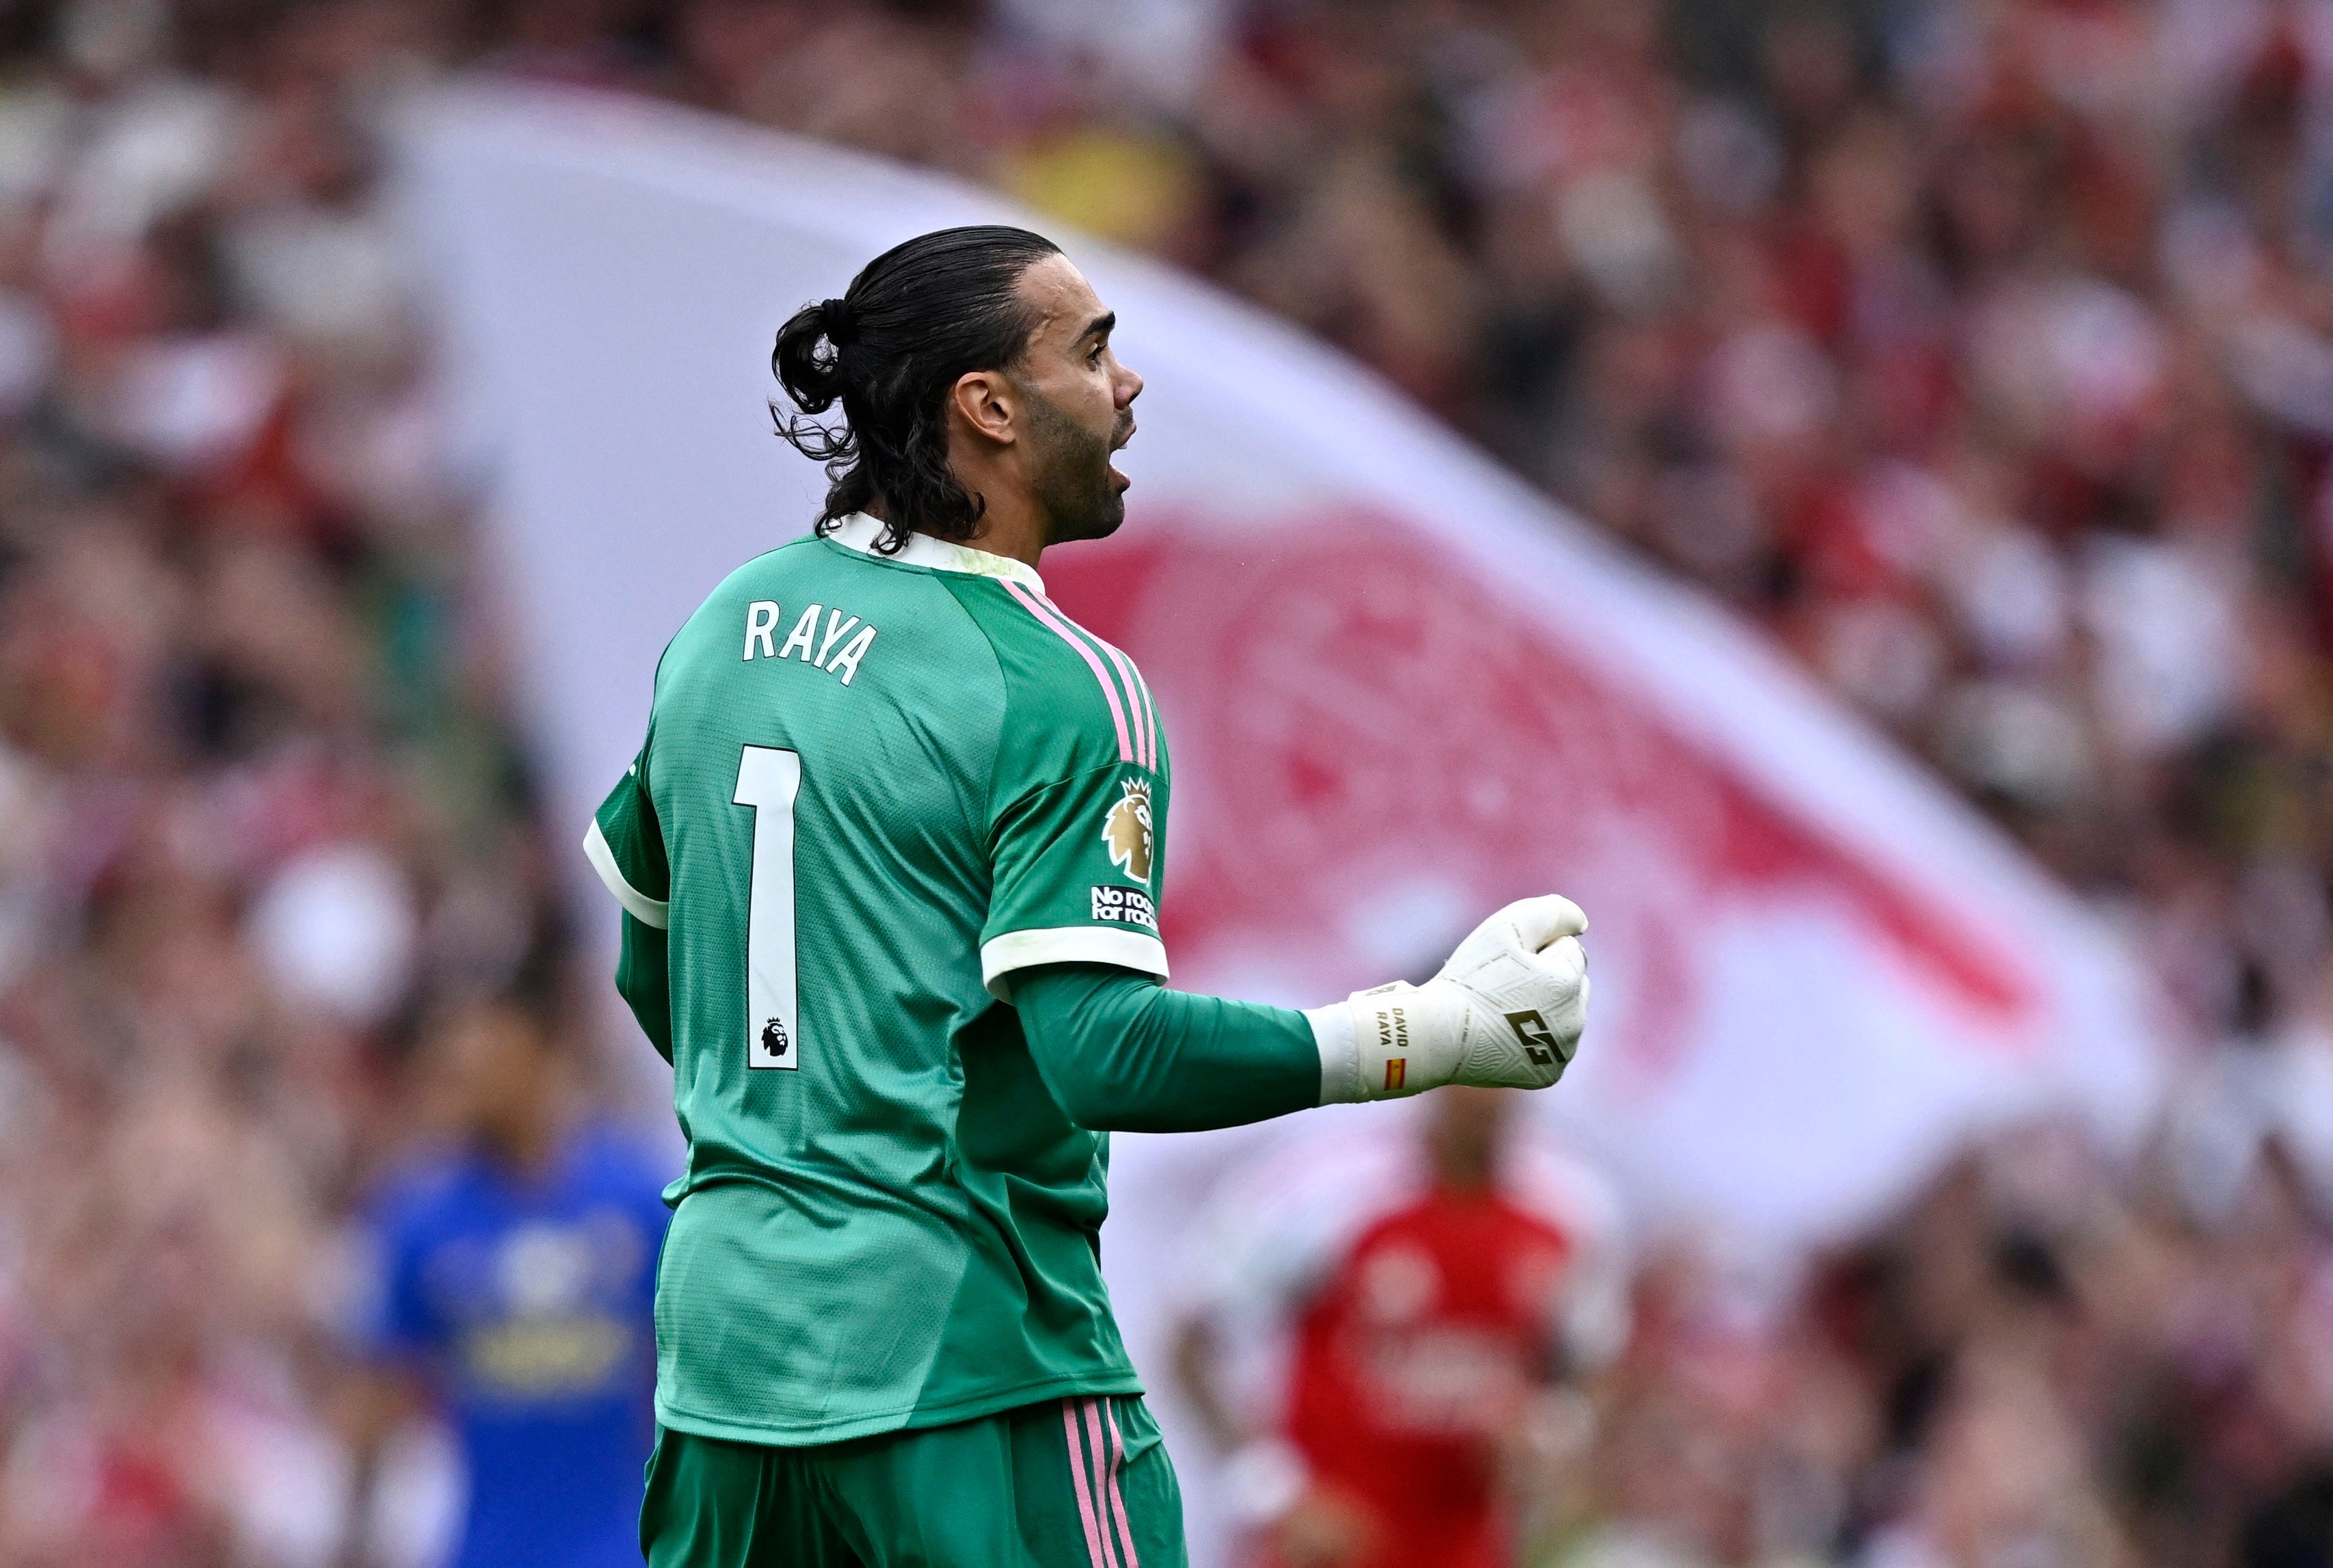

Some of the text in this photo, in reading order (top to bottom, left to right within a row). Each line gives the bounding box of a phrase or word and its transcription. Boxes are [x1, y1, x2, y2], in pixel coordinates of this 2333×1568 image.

[743, 600, 878, 687] RAYA
[731, 743, 802, 1070] 1
[1091, 886, 1123, 905] No
[1092, 903, 1123, 920] for
[1376, 1012, 1392, 1046] RAYA
[1392, 1008, 1409, 1047] DAVID
